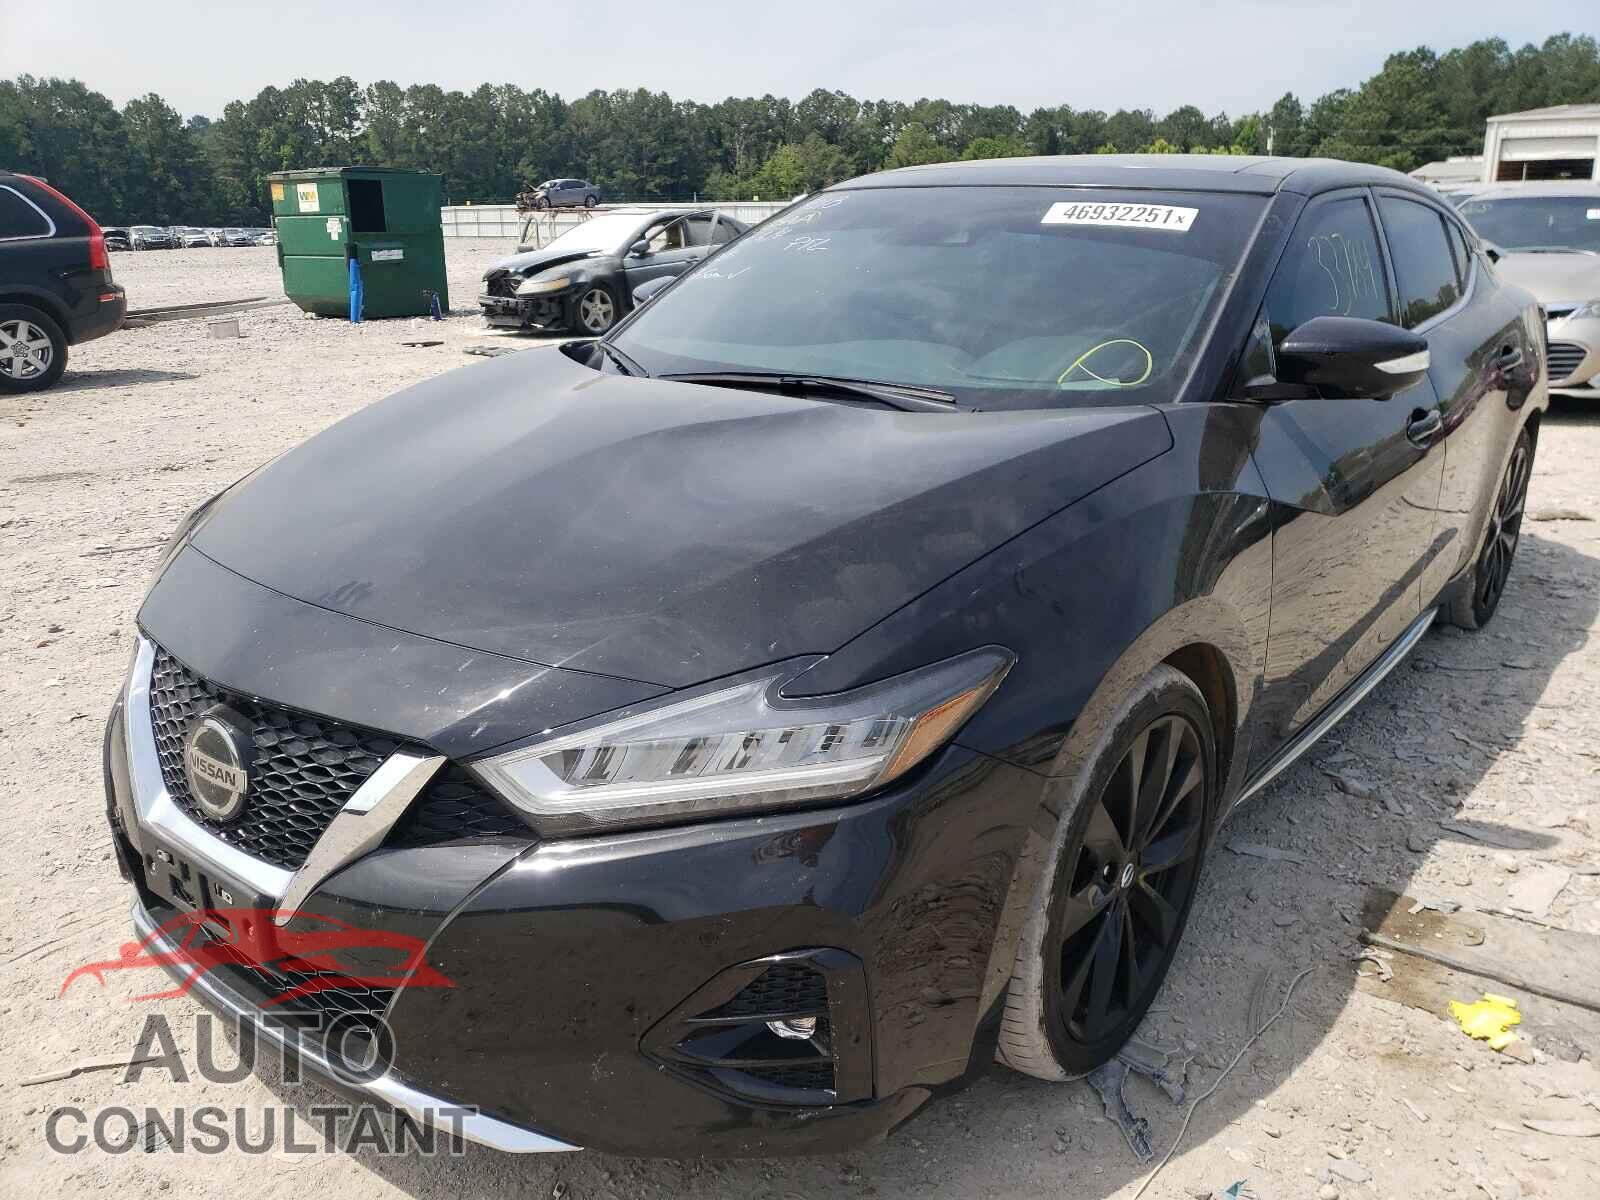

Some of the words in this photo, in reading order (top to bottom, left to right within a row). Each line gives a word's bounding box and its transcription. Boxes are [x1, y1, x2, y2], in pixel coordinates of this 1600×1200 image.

[299, 191, 317, 201] WM
[1063, 204, 1174, 224] 46932251
[191, 754, 237, 787] NISSAN
